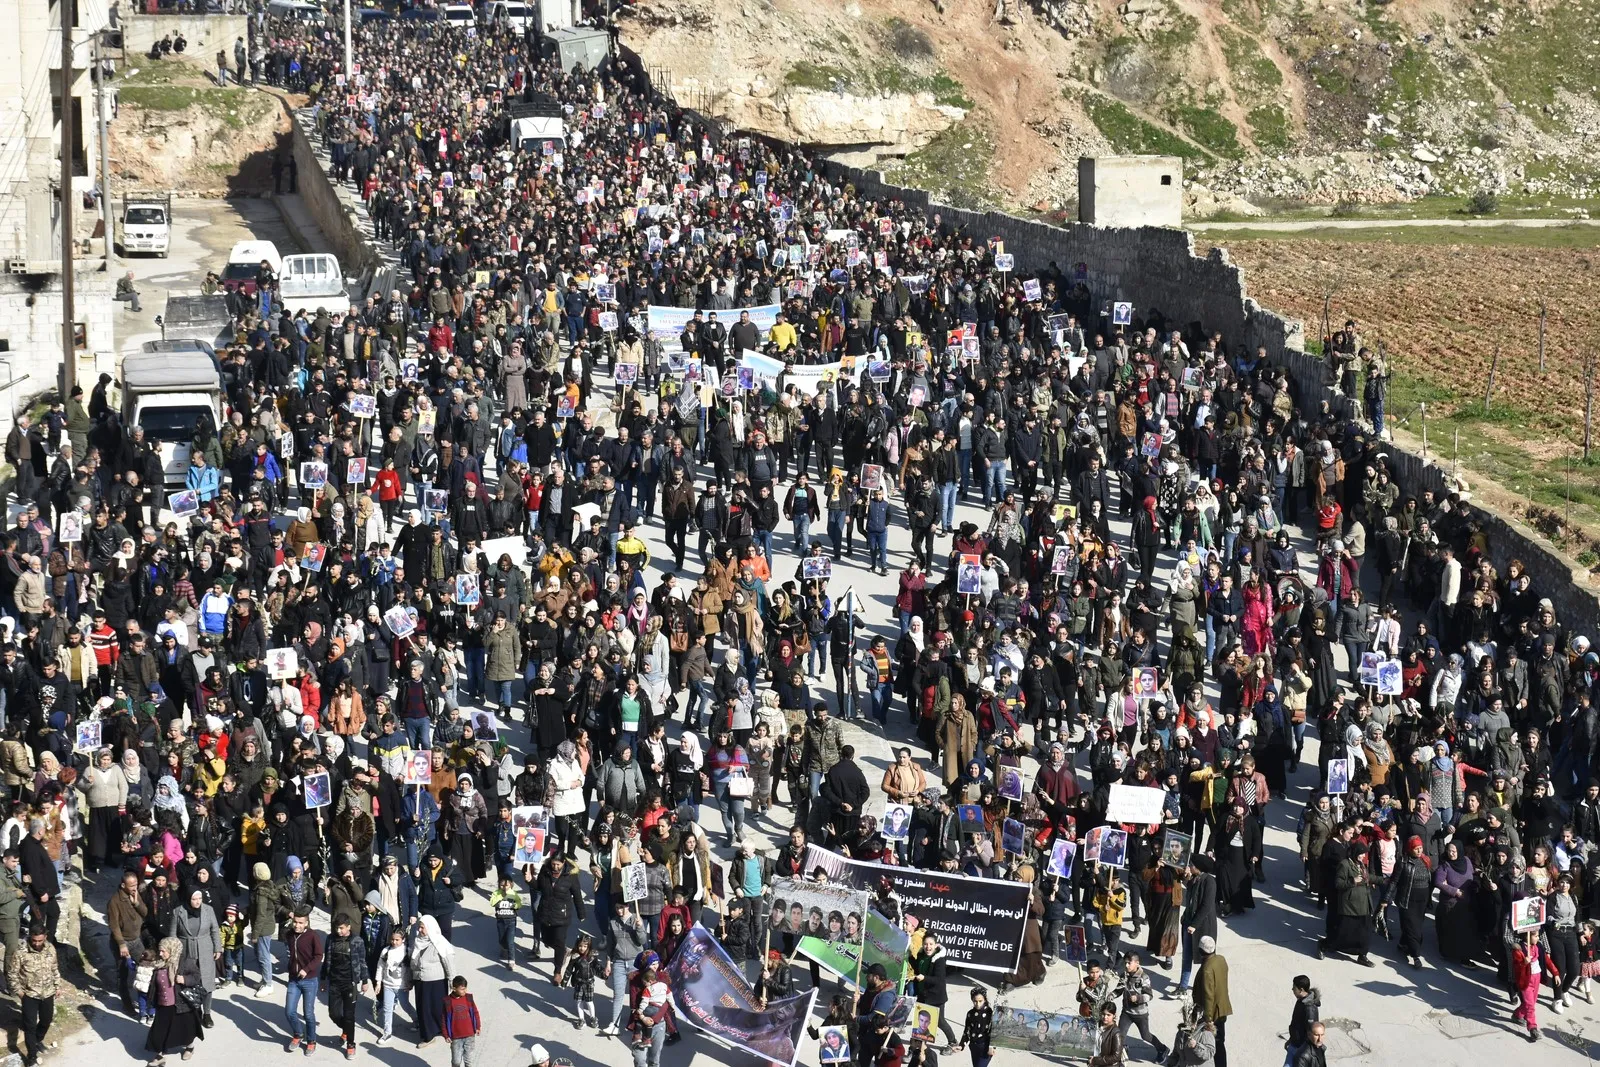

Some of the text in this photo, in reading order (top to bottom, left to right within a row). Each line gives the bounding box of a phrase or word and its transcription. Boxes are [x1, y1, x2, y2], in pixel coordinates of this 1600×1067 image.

[946, 900, 968, 912] الدولة
[993, 908, 1014, 918] يدوم
[1014, 908, 1024, 920] لن
[968, 939, 998, 951] EFRÎNÊ
[1000, 942, 1013, 952] DE
[962, 950, 972, 960] YE
